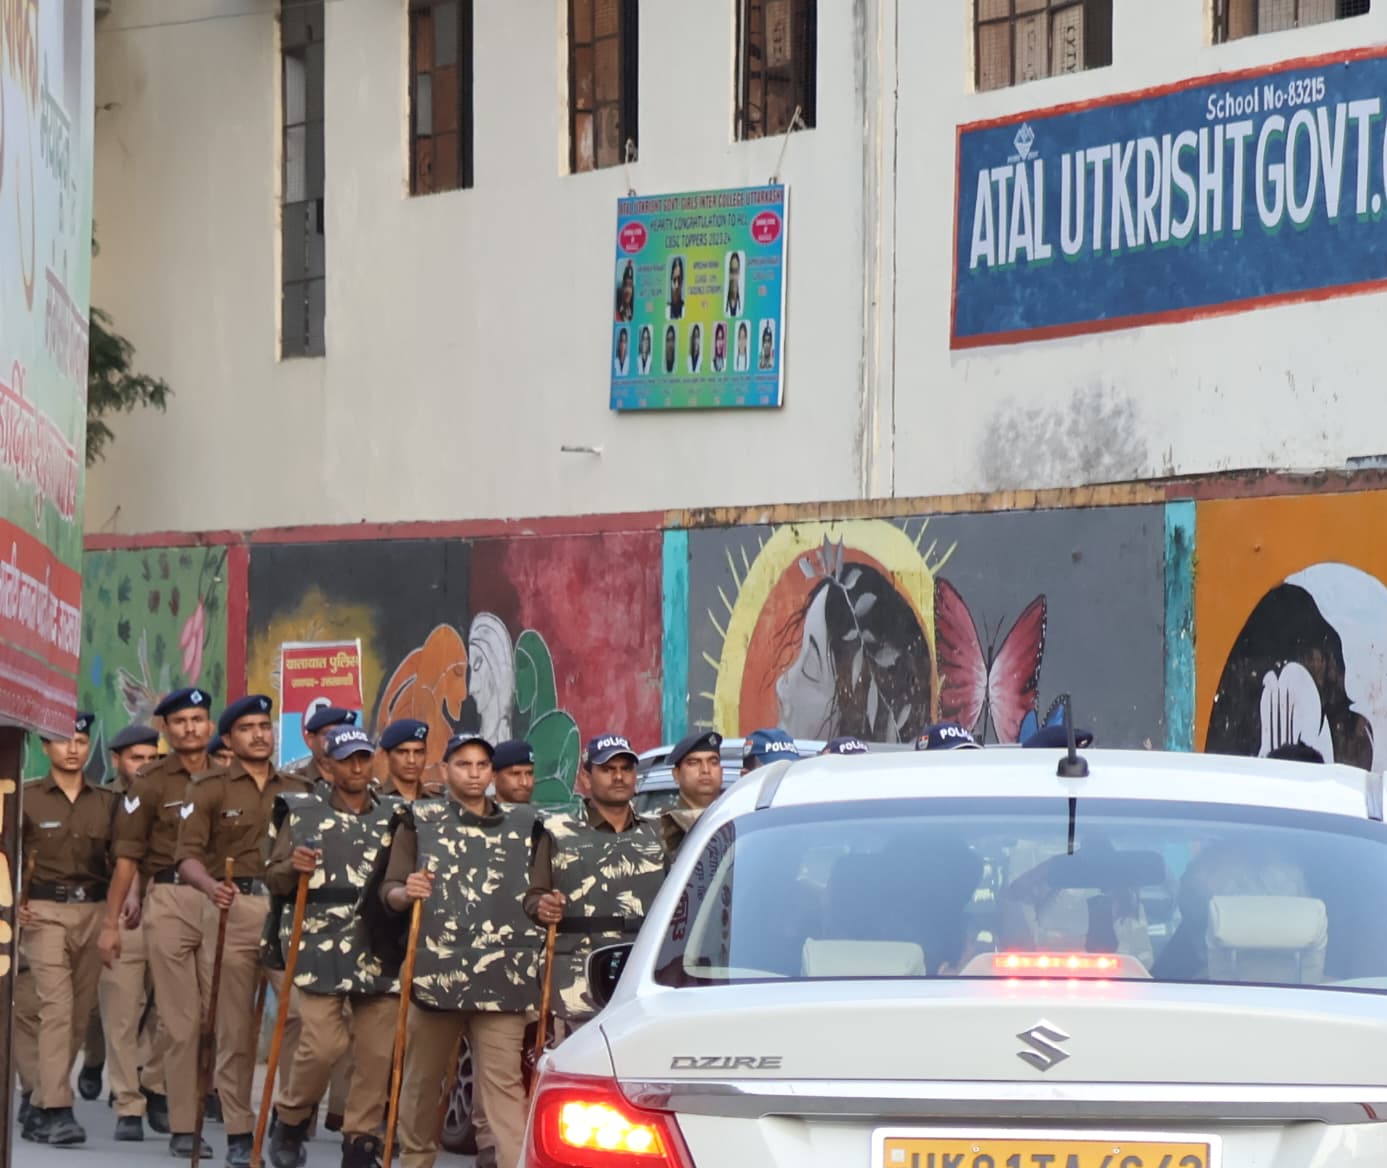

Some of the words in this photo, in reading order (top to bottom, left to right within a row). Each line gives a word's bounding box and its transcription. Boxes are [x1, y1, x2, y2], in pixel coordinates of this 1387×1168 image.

[1206, 86, 1259, 120] School
[970, 158, 1051, 269] ATAL
[1060, 119, 1254, 254] UTKRISHT
[670, 1056, 783, 1070] DZIRE
